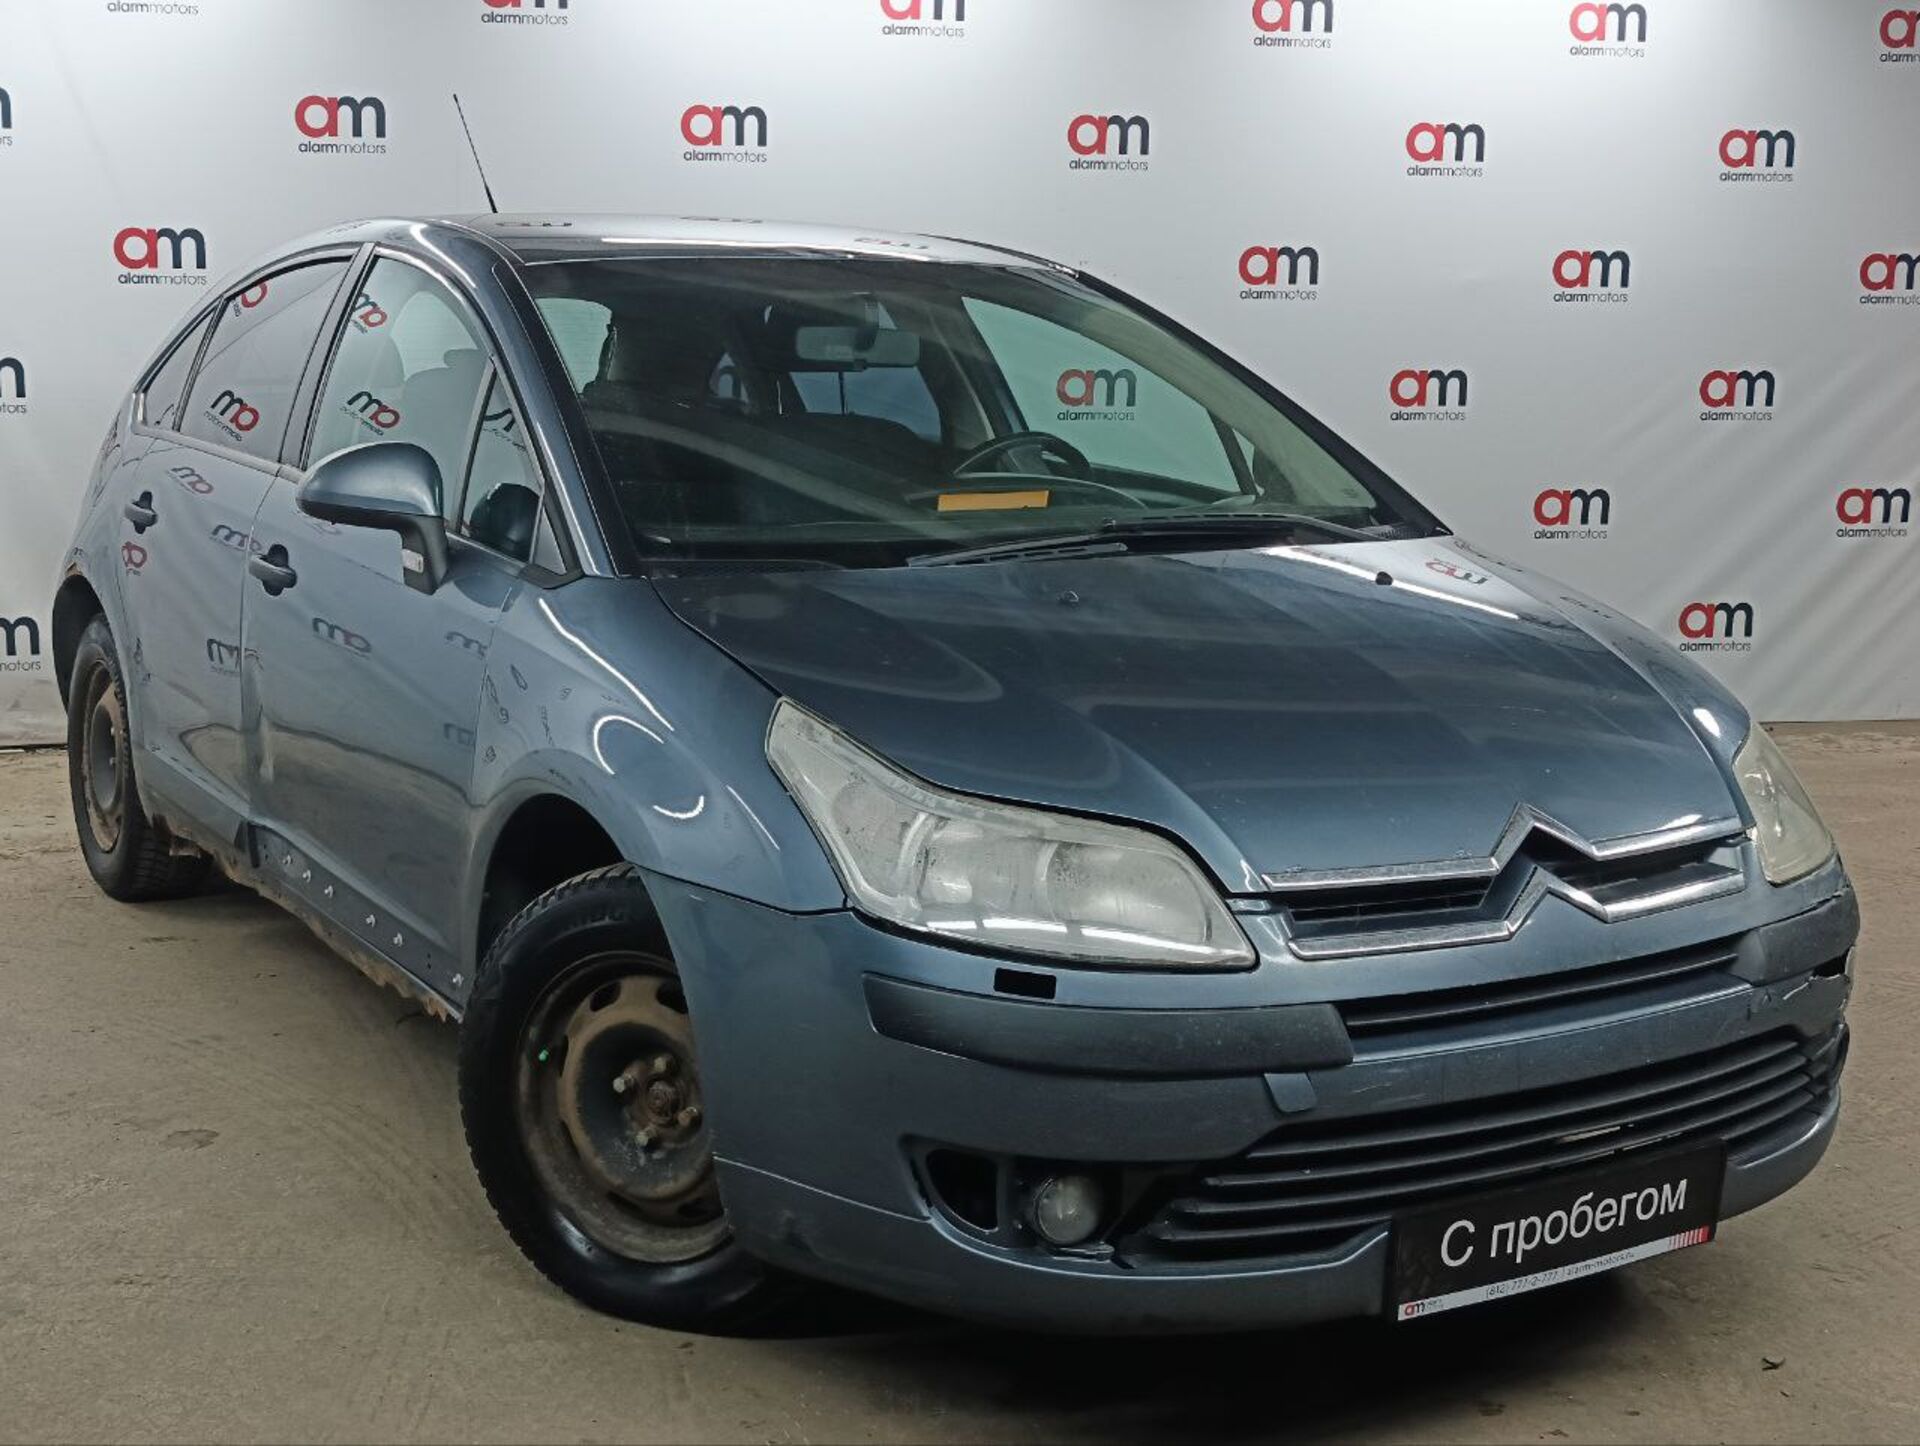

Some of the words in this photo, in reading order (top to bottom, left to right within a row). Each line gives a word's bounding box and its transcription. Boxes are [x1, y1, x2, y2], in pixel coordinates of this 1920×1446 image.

[107, 0, 198, 14] alarmmotors
[481, 11, 568, 24] alarmmotors
[1252, 0, 1333, 33] am
[1569, 3, 1647, 42] am
[882, 24, 964, 37] alarmmotors
[1879, 9, 1920, 48] a
[1253, 34, 1331, 48] alarmmotors
[1570, 45, 1644, 57] alarmmotors
[295, 95, 386, 139] am
[680, 105, 767, 147] am
[1067, 114, 1149, 156] am
[298, 141, 386, 154] alarmmotors
[1405, 122, 1485, 163] am
[1719, 129, 1796, 169] am
[683, 149, 767, 163] alarmmotors
[1069, 158, 1148, 170] alarmmotors
[1407, 165, 1483, 177] alarmmotors
[1719, 171, 1793, 182] alarmmotors
[113, 227, 207, 270] am
[1239, 246, 1319, 285] am
[1552, 250, 1631, 288] am
[118, 272, 207, 285] alarmmotors
[1239, 288, 1317, 300] alarmmotors
[1553, 291, 1628, 302] alarmmotors
[1057, 369, 1137, 407] am
[1389, 369, 1467, 408] am
[1699, 370, 1775, 408] am
[1056, 410, 1134, 421] alarmmotors
[1390, 411, 1466, 421] alarmmotors
[1699, 411, 1772, 421] alarmmotors
[1533, 489, 1610, 526] am
[1836, 488, 1911, 524] am
[1534, 528, 1607, 539] alarmmotors
[1836, 526, 1907, 537] alarmmotors
[1678, 602, 1754, 639] am
[1679, 641, 1751, 652] alarmmotors
[1440, 1220, 1475, 1267] С
[1490, 1178, 1687, 1264] пробегом
